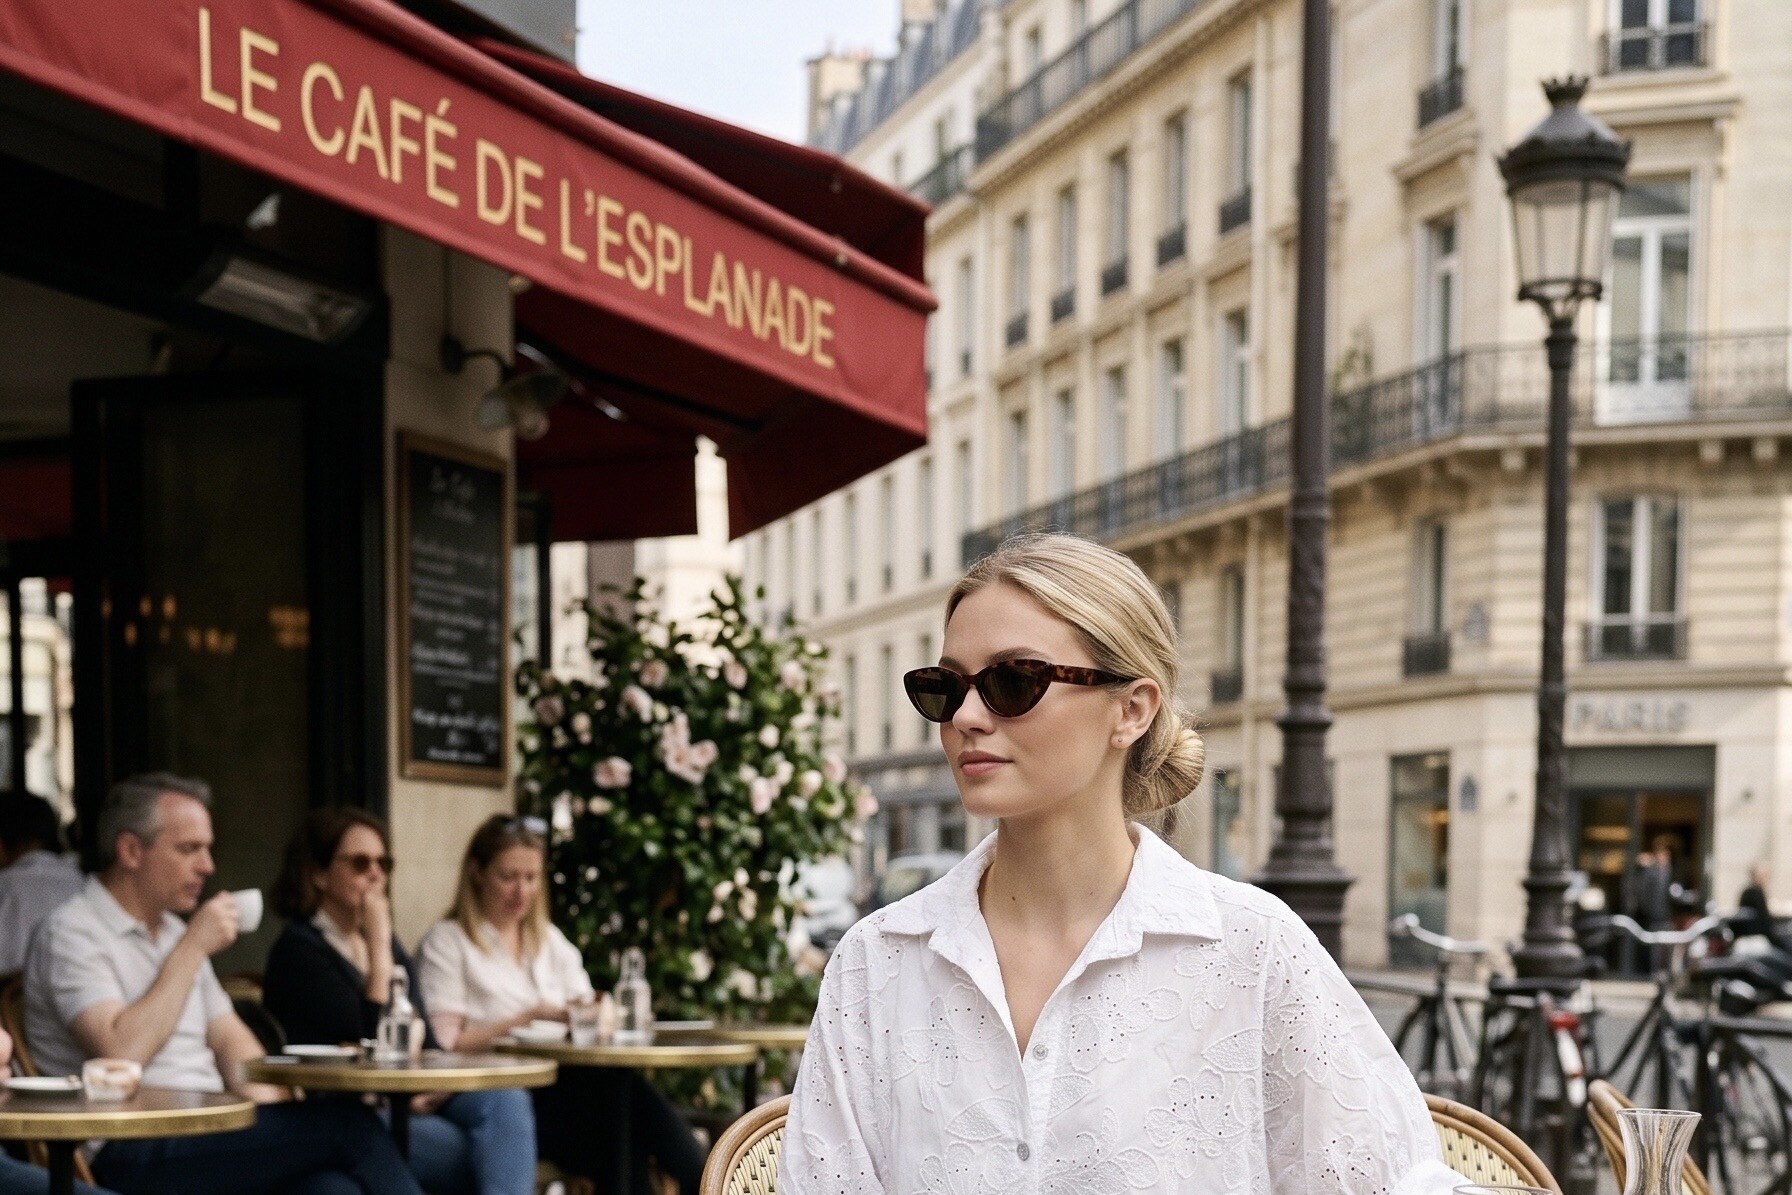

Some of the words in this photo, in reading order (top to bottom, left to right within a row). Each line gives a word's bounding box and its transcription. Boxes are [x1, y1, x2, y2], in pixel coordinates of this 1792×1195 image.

[198, 7, 282, 131] LE
[300, 62, 459, 209] CAFÉ
[475, 139, 548, 247] DE
[559, 177, 837, 370] L'ESPLANADE
